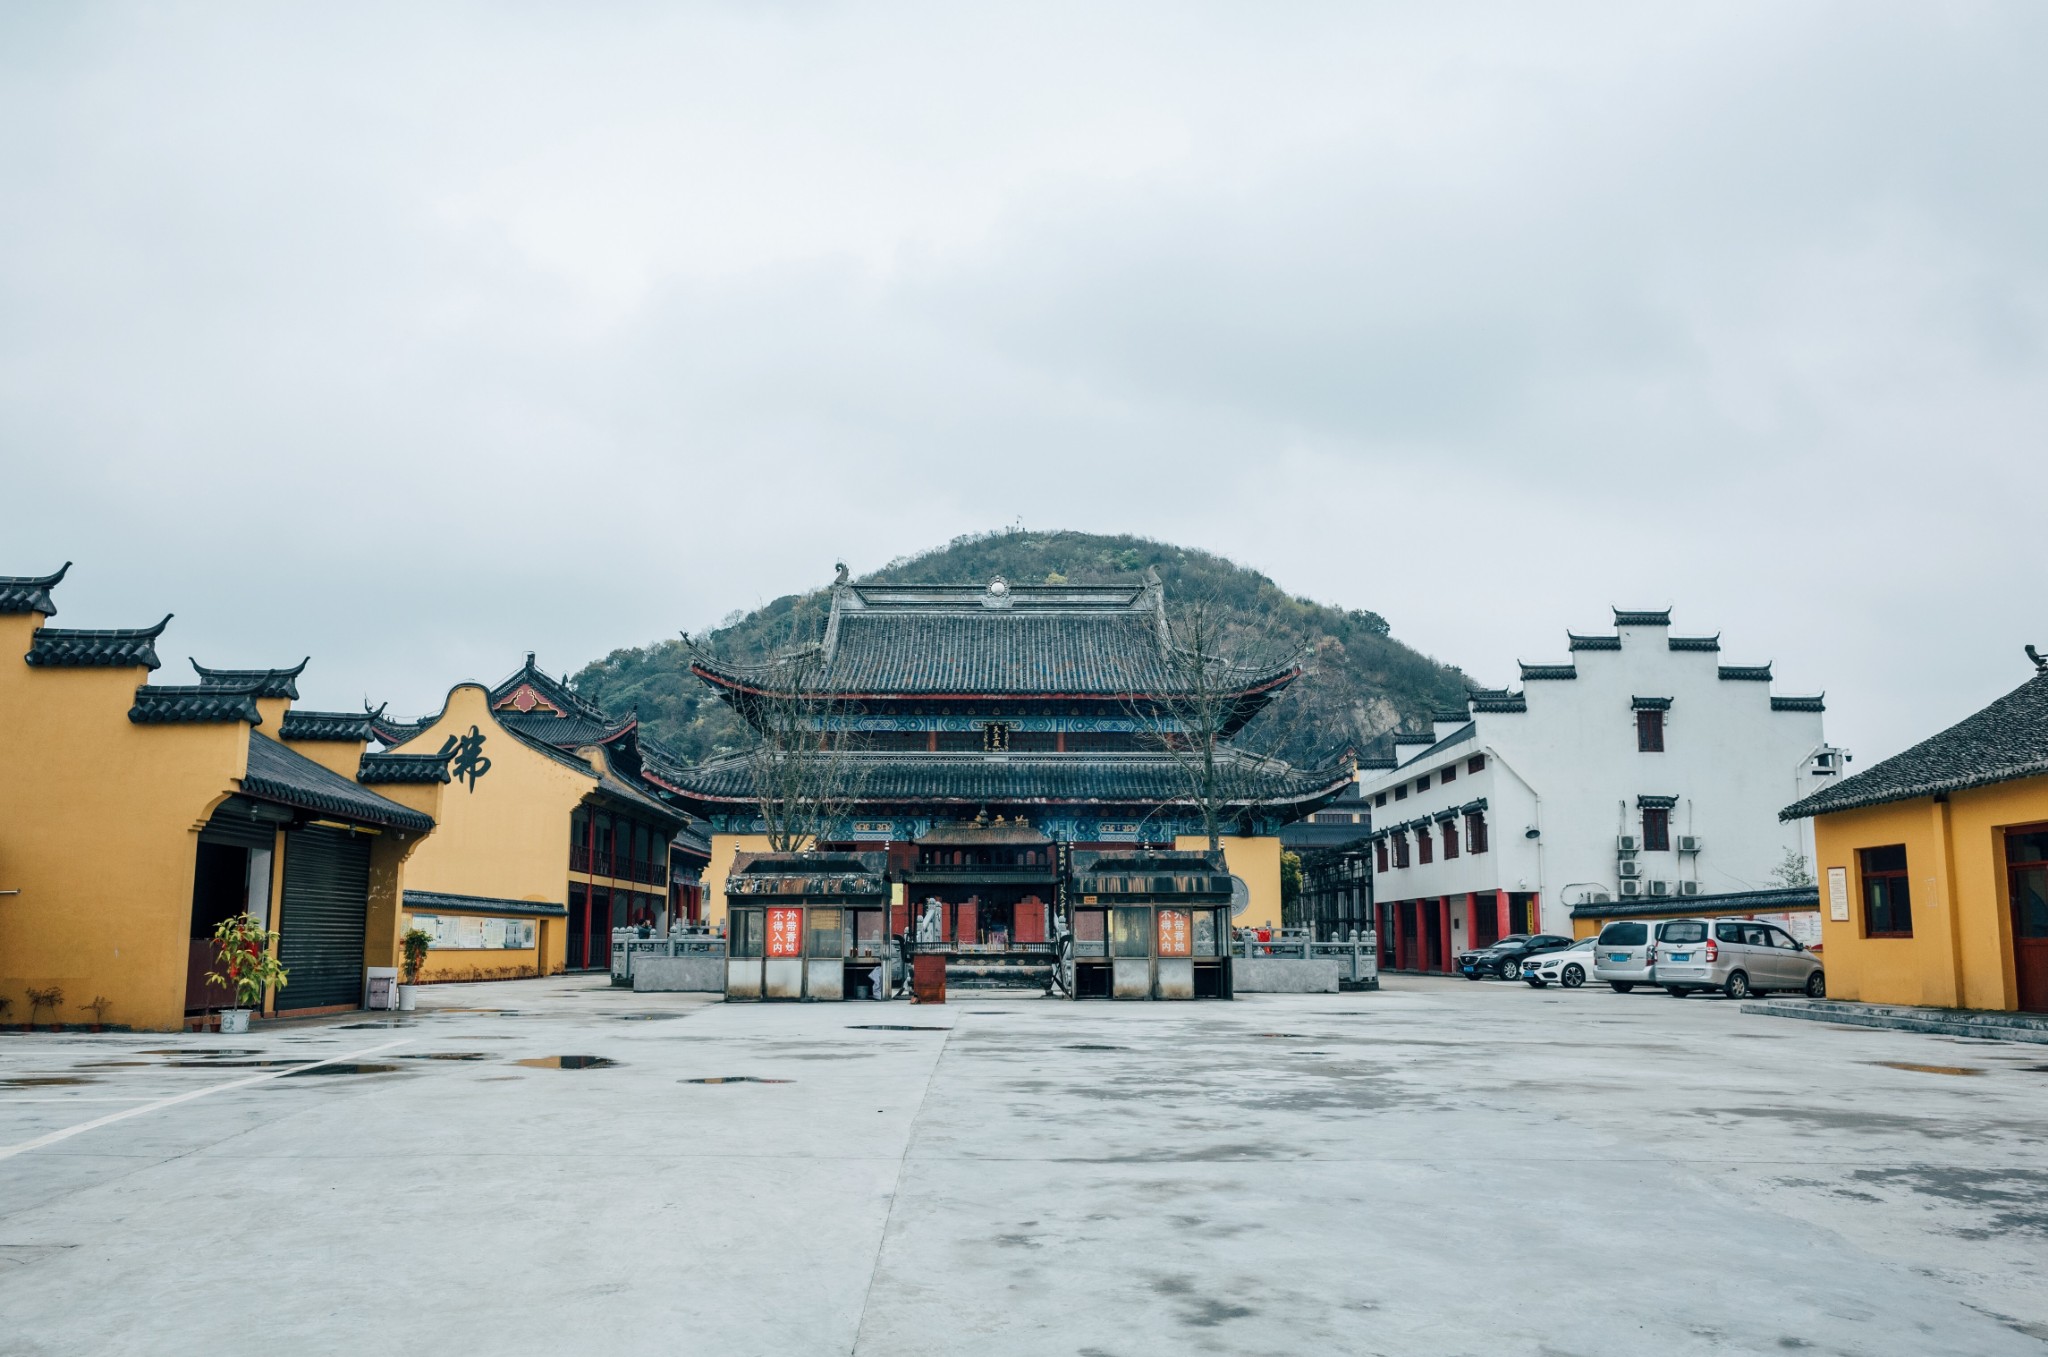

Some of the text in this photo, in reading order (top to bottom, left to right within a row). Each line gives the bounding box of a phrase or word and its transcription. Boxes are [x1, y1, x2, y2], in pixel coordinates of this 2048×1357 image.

[437, 725, 491, 794] 佛
[773, 911, 784, 953] 不得入内
[786, 910, 797, 951] 外带香烛
[1161, 910, 1171, 952] 不得入内
